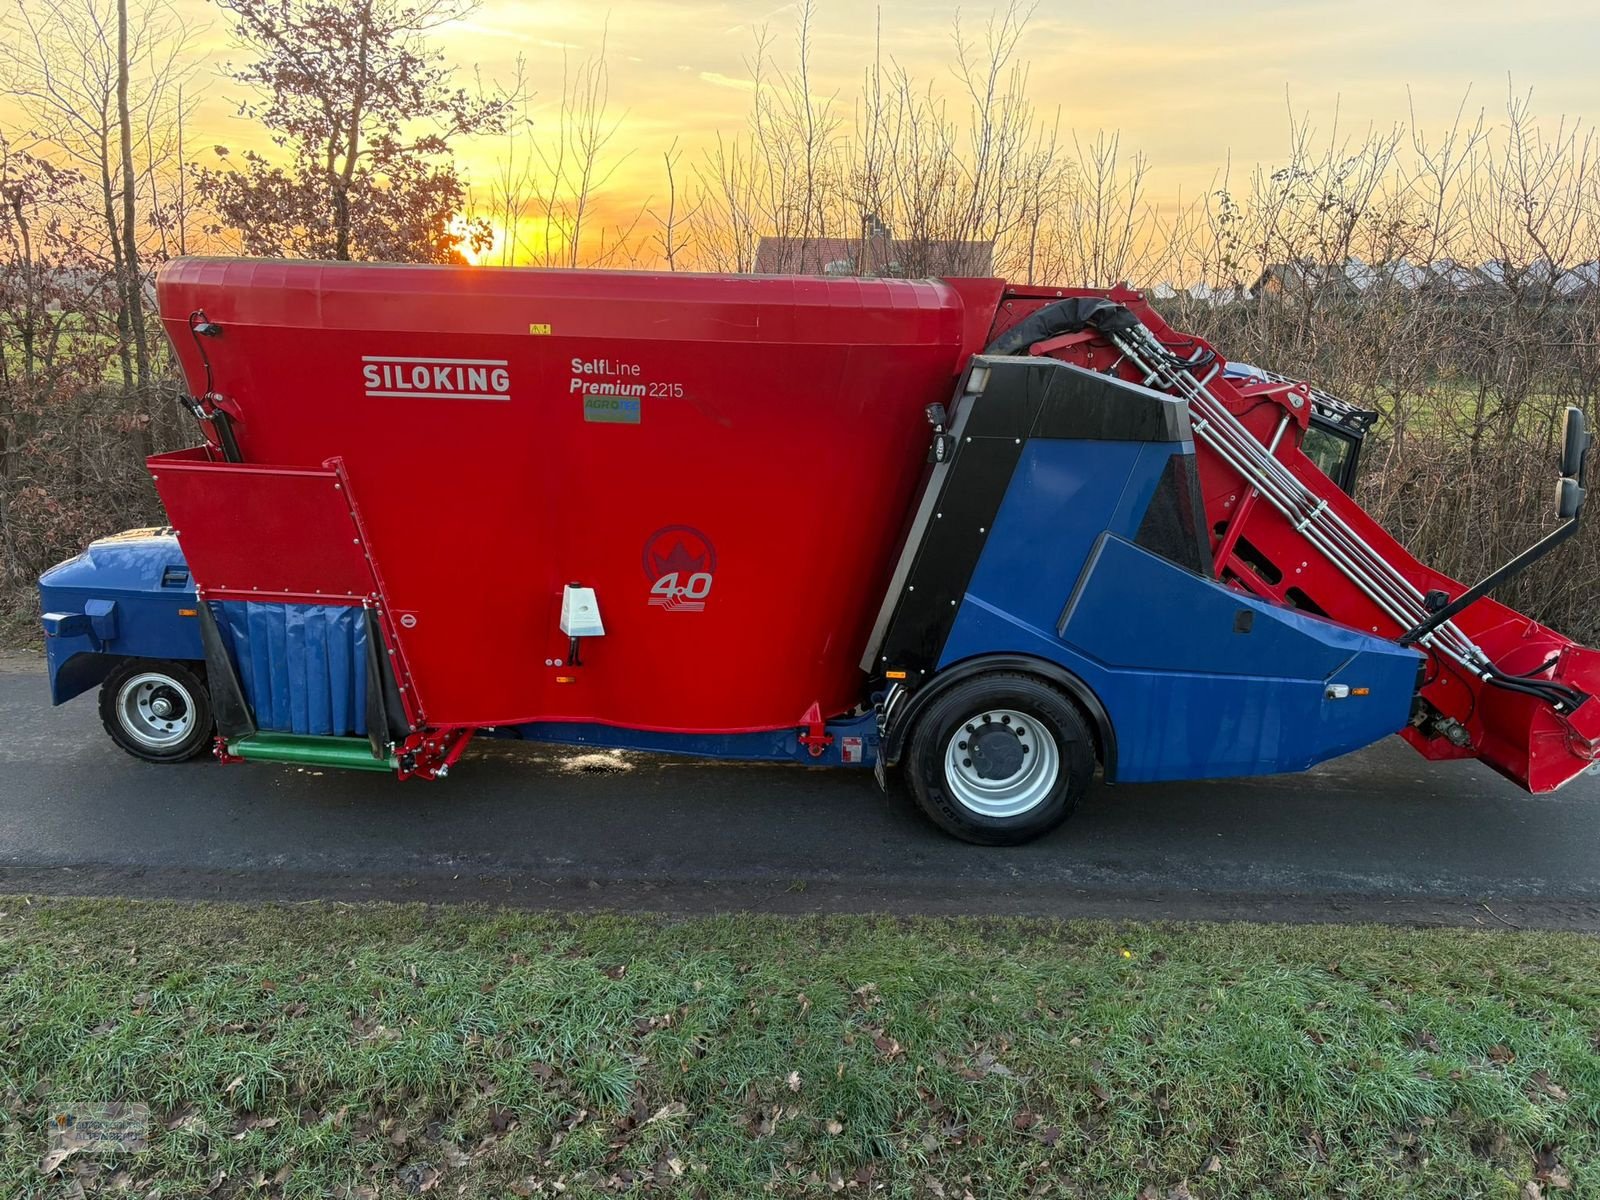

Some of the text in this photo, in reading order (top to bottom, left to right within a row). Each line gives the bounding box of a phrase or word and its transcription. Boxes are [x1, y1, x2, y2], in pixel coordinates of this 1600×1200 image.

[571, 358, 641, 376] SelfLine
[362, 364, 511, 392] SILOKING
[569, 378, 684, 398] Premium 2215
